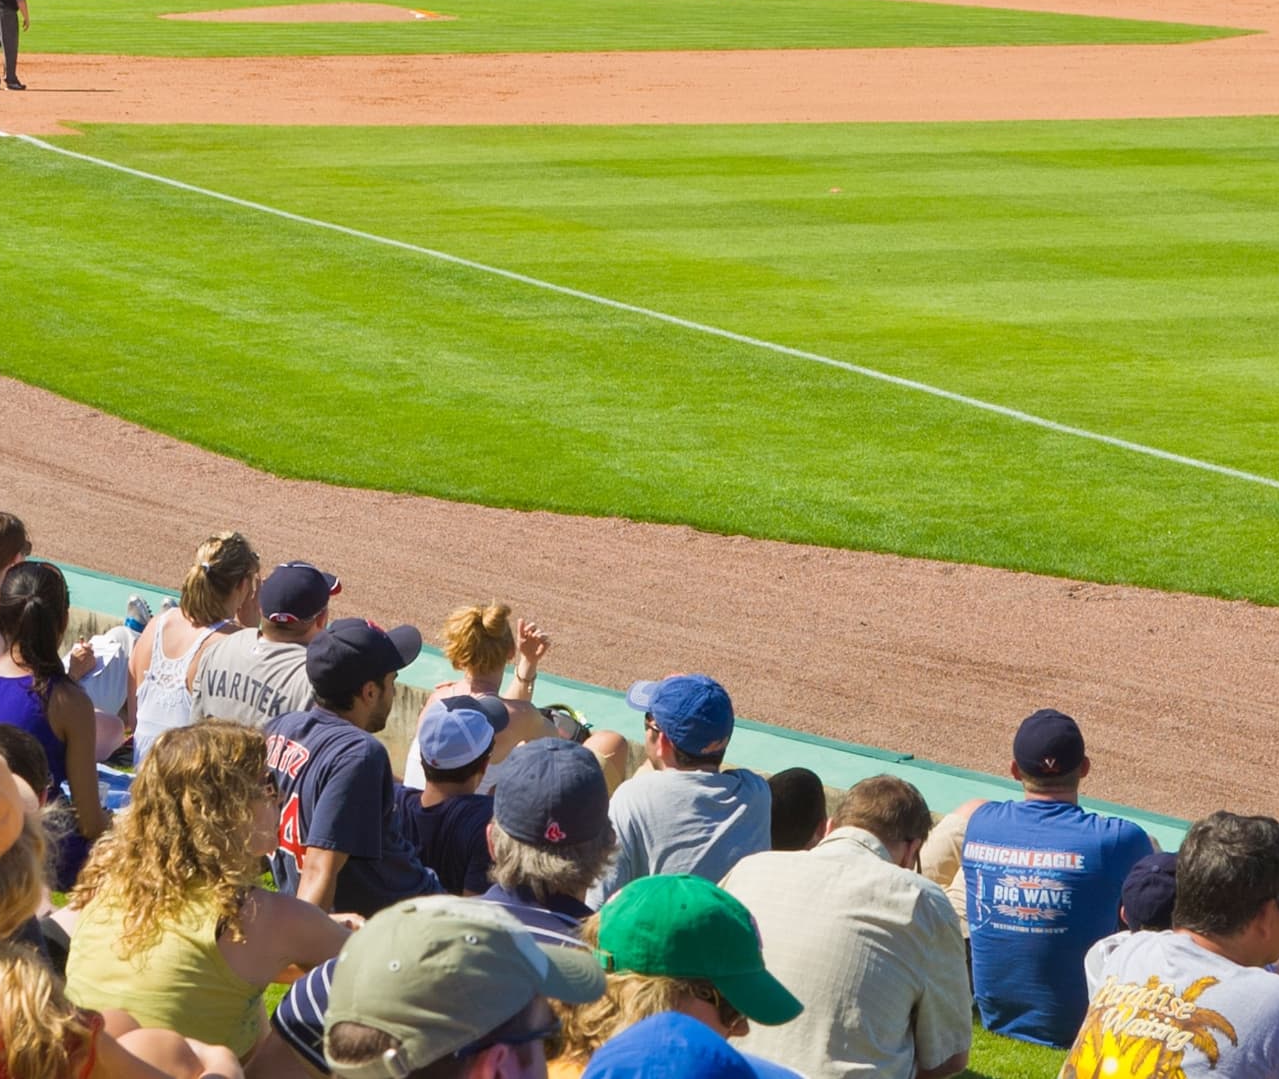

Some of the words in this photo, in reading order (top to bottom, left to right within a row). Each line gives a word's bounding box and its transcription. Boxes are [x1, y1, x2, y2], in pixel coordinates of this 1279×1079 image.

[207, 669, 288, 718] VARITEK
[265, 734, 310, 780] RTIZ
[1044, 758, 1056, 769] V
[1033, 851, 1085, 870] EAGLE
[994, 884, 1019, 903] BIG
[1024, 887, 1072, 905] WAVE
[1093, 975, 1197, 1021] Paradise
[1102, 1004, 1195, 1052] Waiting
